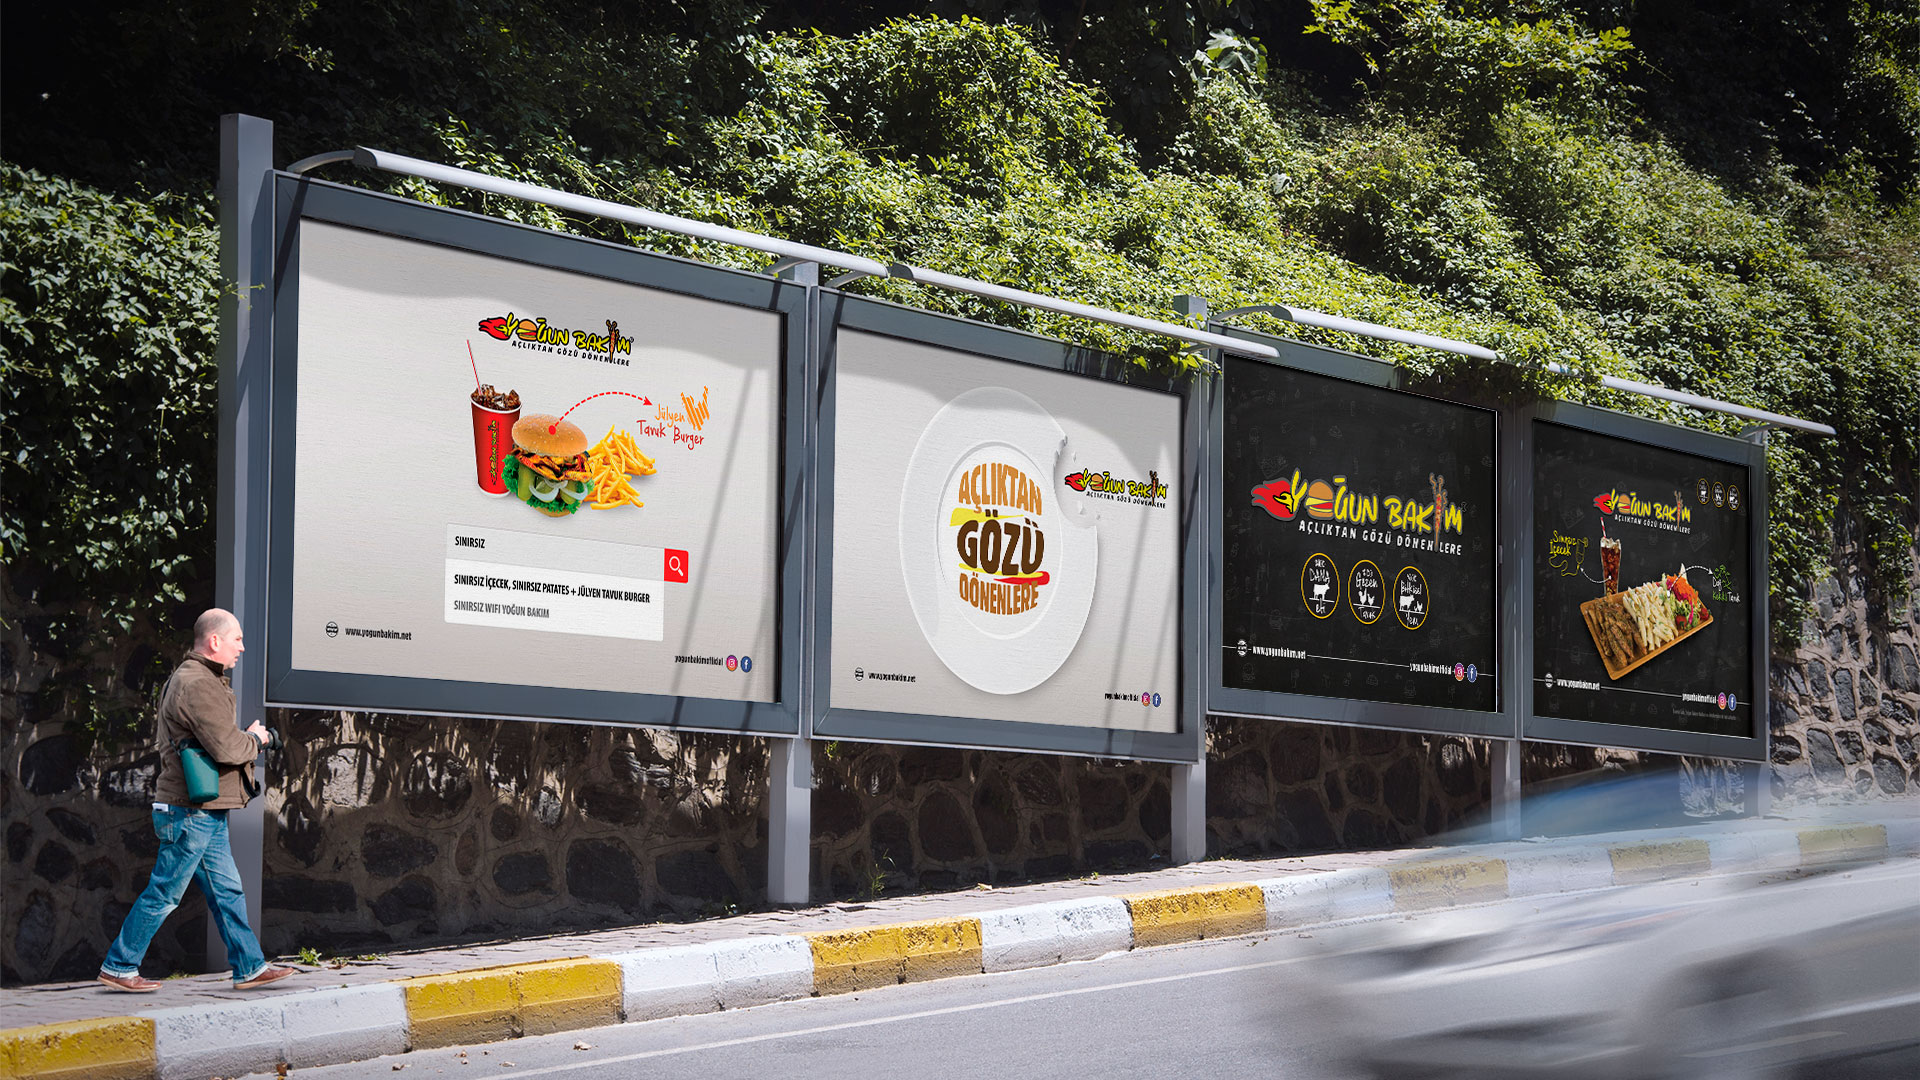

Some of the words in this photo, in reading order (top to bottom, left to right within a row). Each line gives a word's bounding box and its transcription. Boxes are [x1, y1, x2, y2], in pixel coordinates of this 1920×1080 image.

[511, 340, 553, 354] AÇLIKTAN
[557, 347, 578, 359] GÖZÜ
[654, 403, 686, 428] Jülyen
[636, 419, 667, 438] Tavuk
[672, 425, 705, 451] Burger
[958, 462, 1043, 516] AÇLIKTAN
[454, 535, 486, 549] SINIRSIZ
[957, 508, 1045, 576] GÖZÜ
[1298, 519, 1357, 540] AÇLIKTAN
[1362, 529, 1392, 546] GÖZÜ
[454, 574, 485, 587] SINIRSIZ
[485, 575, 511, 591] İÇECEK,
[512, 579, 542, 593] SINIRSIZ
[542, 583, 570, 596] PATATES
[577, 585, 601, 599] JÜLYEN
[602, 589, 624, 601] TAVUK
[624, 591, 650, 604] BURGER
[959, 571, 1039, 616] DÖNENLERE
[454, 600, 484, 613] SINIRSIZ
[485, 603, 501, 614] WIFI
[502, 604, 526, 617] YOĞUN
[527, 607, 550, 619] BAKIM
[345, 627, 412, 641] www.yogunbakim.net
